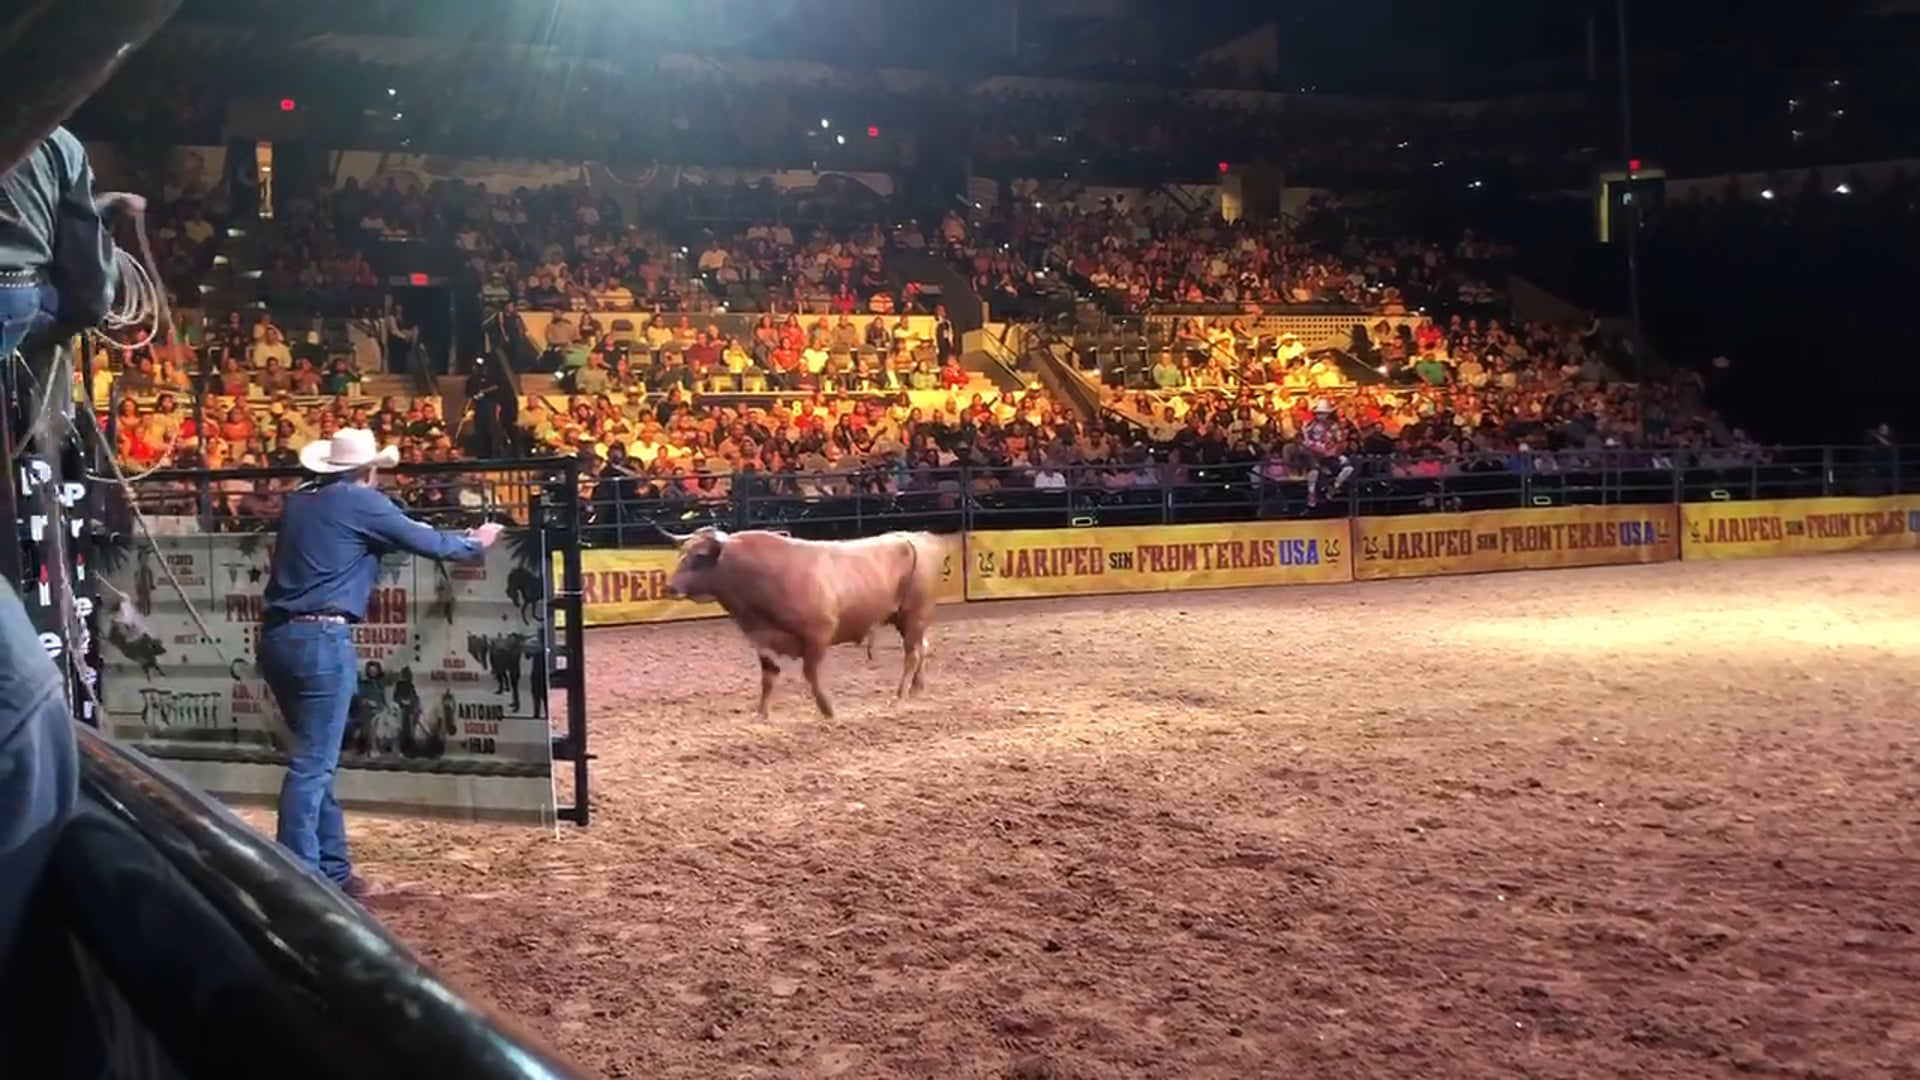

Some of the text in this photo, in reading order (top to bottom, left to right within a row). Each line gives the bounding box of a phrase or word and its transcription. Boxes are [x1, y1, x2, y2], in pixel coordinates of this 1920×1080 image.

[1382, 529, 1472, 560] JARIPEO
[1501, 522, 1616, 553] FRONTERAS
[1618, 521, 1654, 546] USA
[1704, 516, 1784, 543] JARIPEO
[1805, 510, 1906, 539] FRONTERAS
[1000, 539, 1319, 579] JARIPEO SIN FRONTERAS USA
[581, 568, 667, 604] RIPEO
[458, 703, 504, 721] ANTONIO
